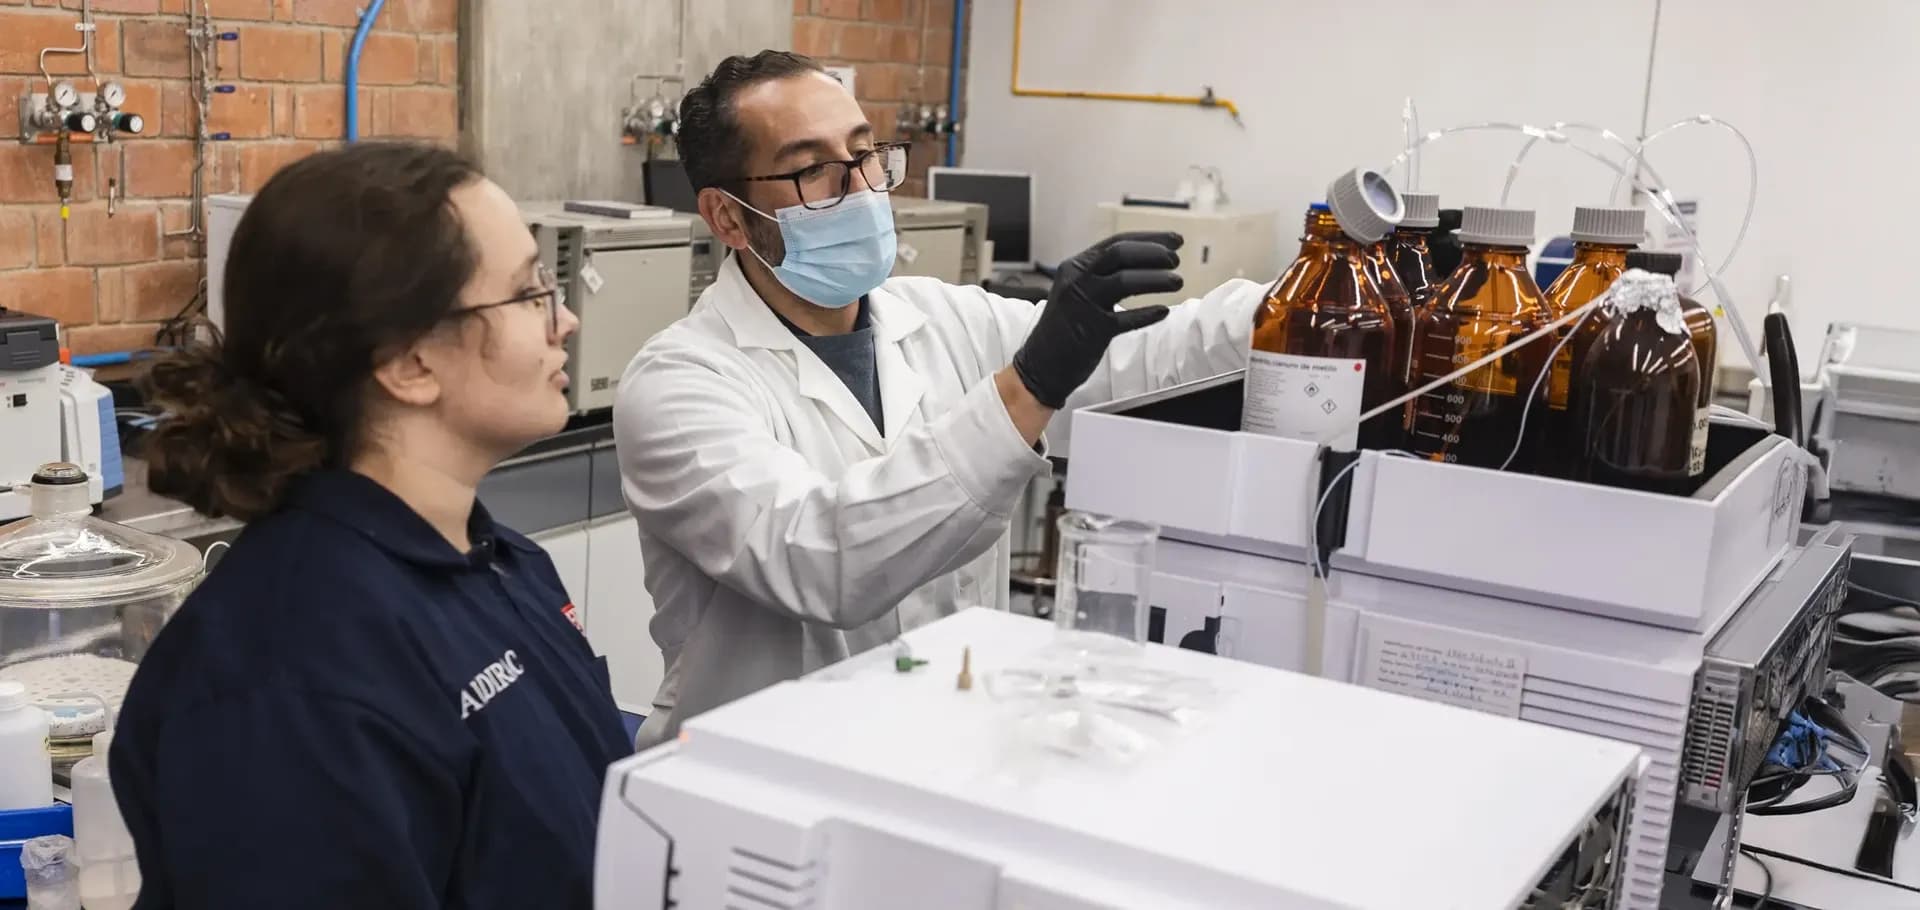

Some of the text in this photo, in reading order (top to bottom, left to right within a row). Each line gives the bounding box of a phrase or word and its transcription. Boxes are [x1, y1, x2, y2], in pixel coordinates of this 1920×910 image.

[1446, 394, 1465, 404] 600
[1444, 413, 1462, 424] 500
[1441, 433, 1460, 443] 400
